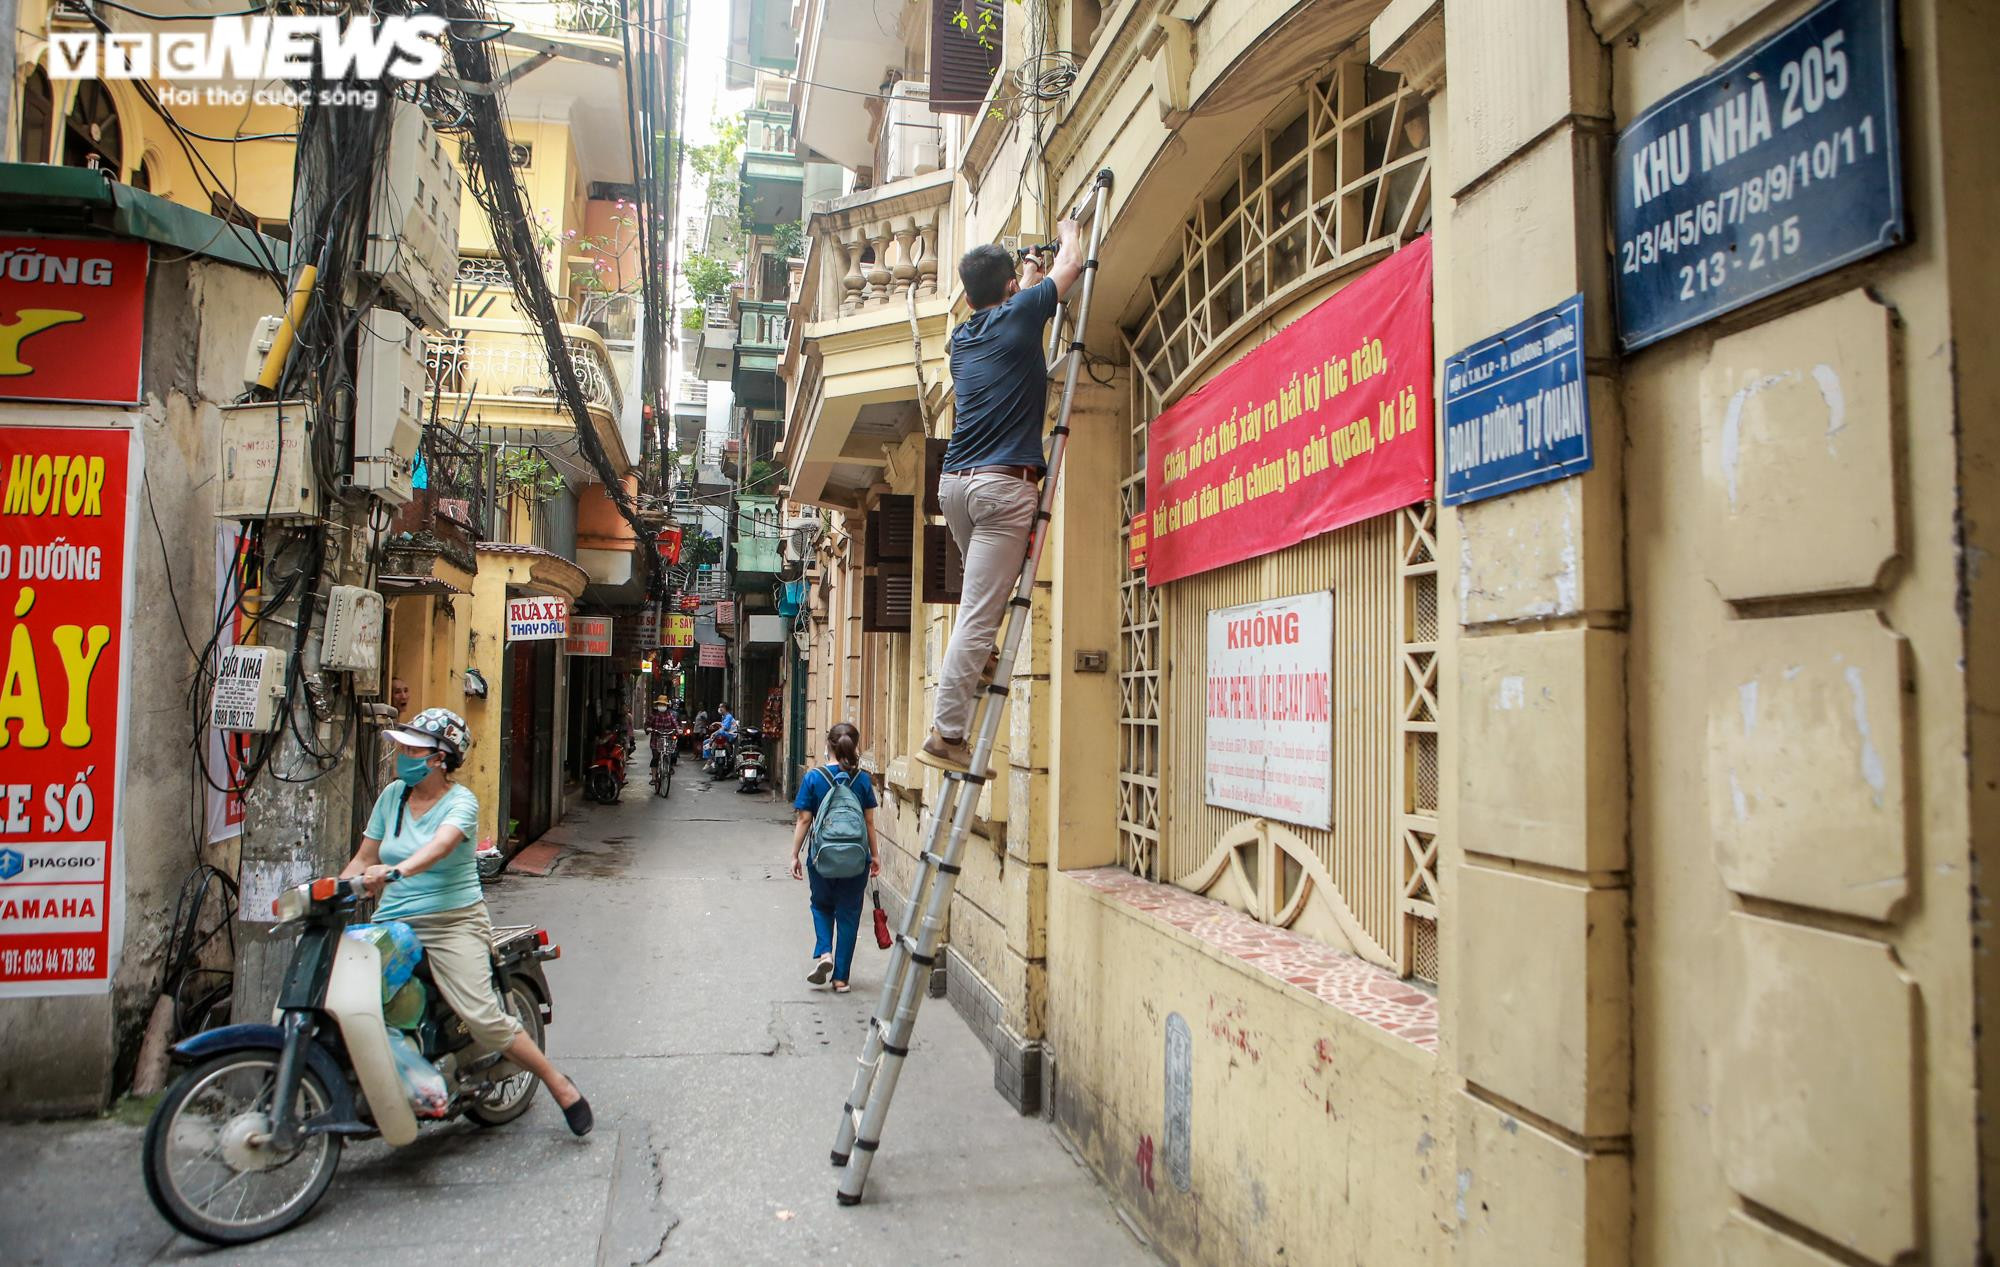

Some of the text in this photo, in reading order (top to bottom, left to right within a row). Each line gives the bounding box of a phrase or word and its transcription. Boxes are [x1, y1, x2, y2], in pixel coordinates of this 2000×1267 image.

[1633, 29, 1847, 208] KHU NHÀ 205
[1622, 115, 1875, 274] 2/3/4/5/6/7/8/9/10/11
[1680, 251, 1726, 301] 213
[1749, 215, 1801, 271] 215
[1164, 336, 1387, 484] Cháy, nổ có thể xảy ra bất kỳ lúc nào,
[1526, 388, 1543, 460] TỰ
[3, 454, 105, 516] MOTOR
[1153, 385, 1417, 539] bất cứ nơi đâu nếu chúng ta chủ quan, lơ là
[18, 536, 102, 580] DƯỠNG
[511, 622, 539, 635] THAY
[1227, 610, 1300, 650] KHÔNG
[241, 711, 255, 727] 172
[0, 765, 95, 833] E SỐ
[29, 857, 96, 868] PIAGGIO
[0, 898, 96, 920] AMAHA
[24, 948, 43, 974] 033
[46, 949, 59, 972] 44
[62, 947, 74, 972] 79
[77, 947, 95, 972] 382
